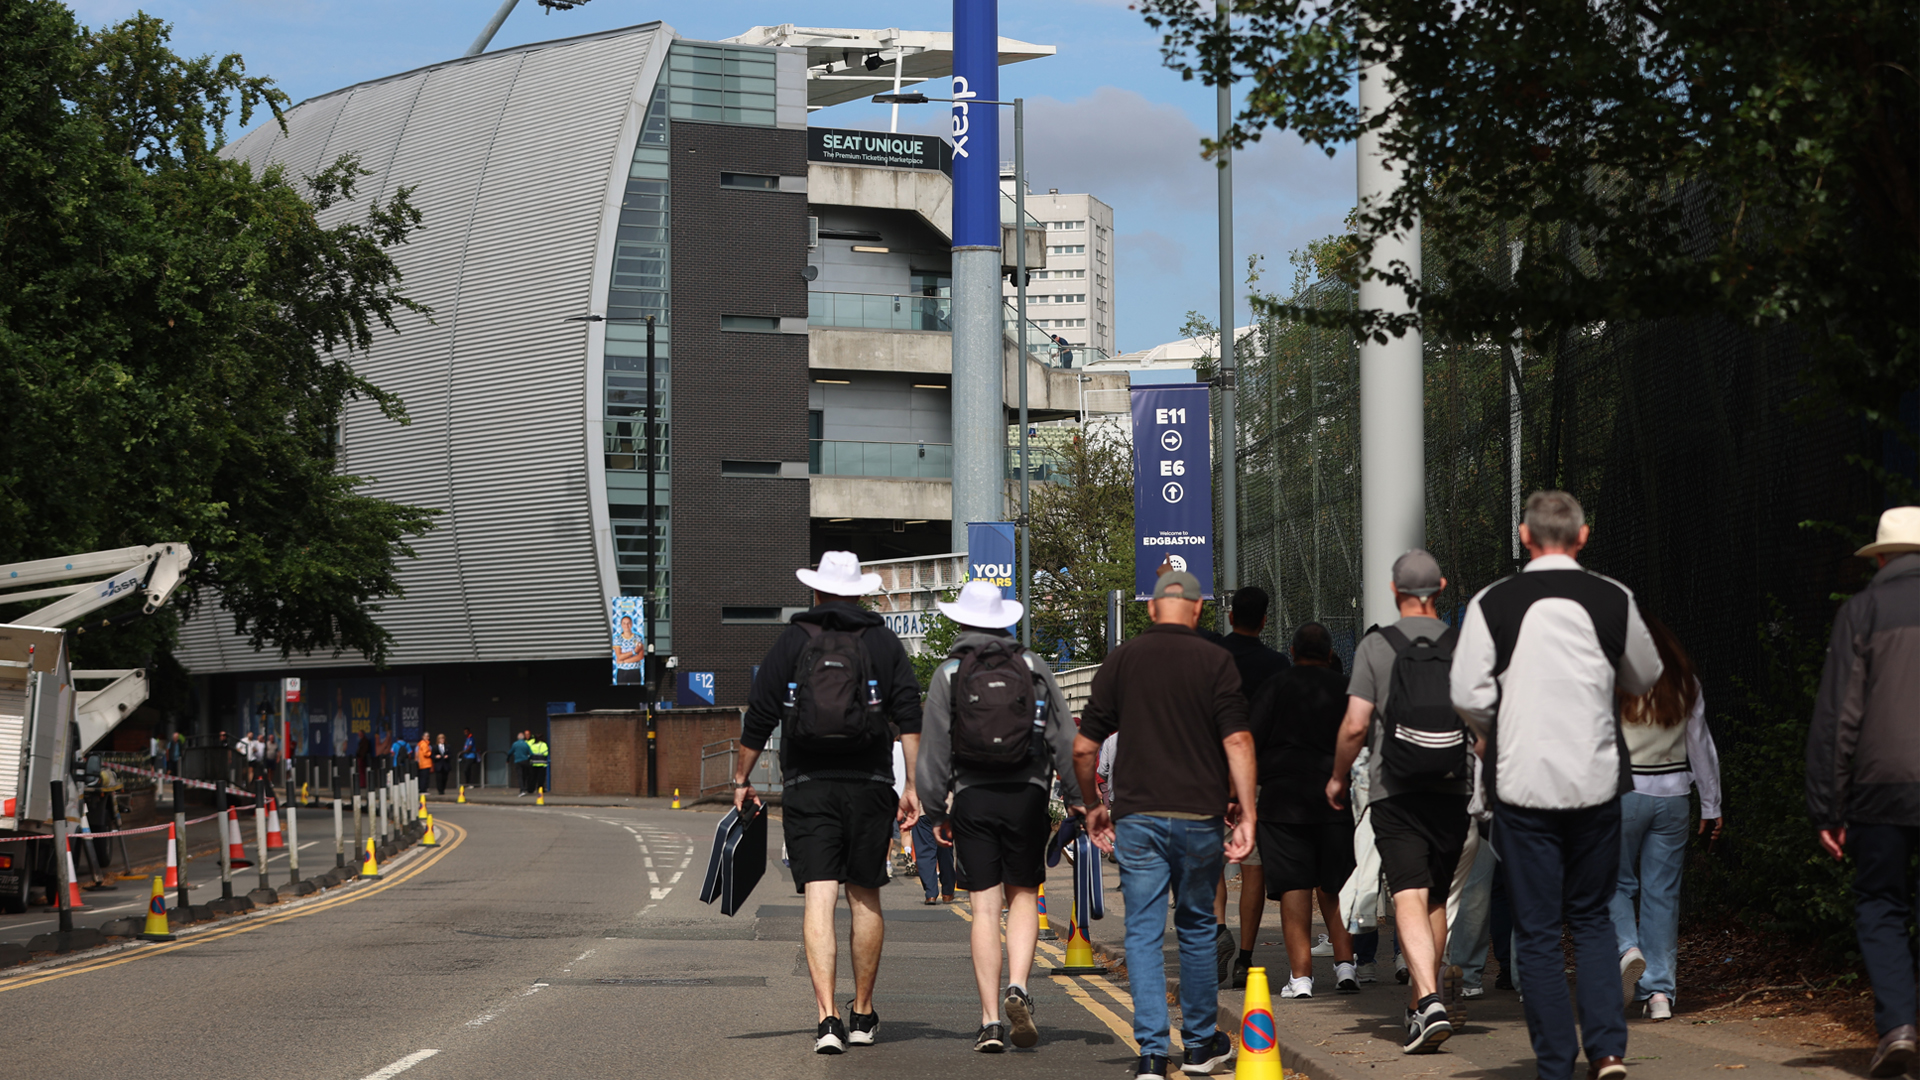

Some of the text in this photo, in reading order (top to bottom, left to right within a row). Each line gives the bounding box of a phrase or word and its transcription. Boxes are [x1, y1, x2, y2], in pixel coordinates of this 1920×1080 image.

[952, 76, 977, 160] drax
[823, 134, 924, 156] SEAT UNIQUE
[835, 152, 861, 160] Premium
[862, 153, 888, 163] Ticketing
[889, 155, 923, 165] Marketplace
[1156, 408, 1186, 424] E11
[1160, 460, 1185, 477] E6
[1143, 536, 1205, 546] EDGBASTON
[973, 563, 1012, 578] YOU
[351, 697, 370, 718] YOU
